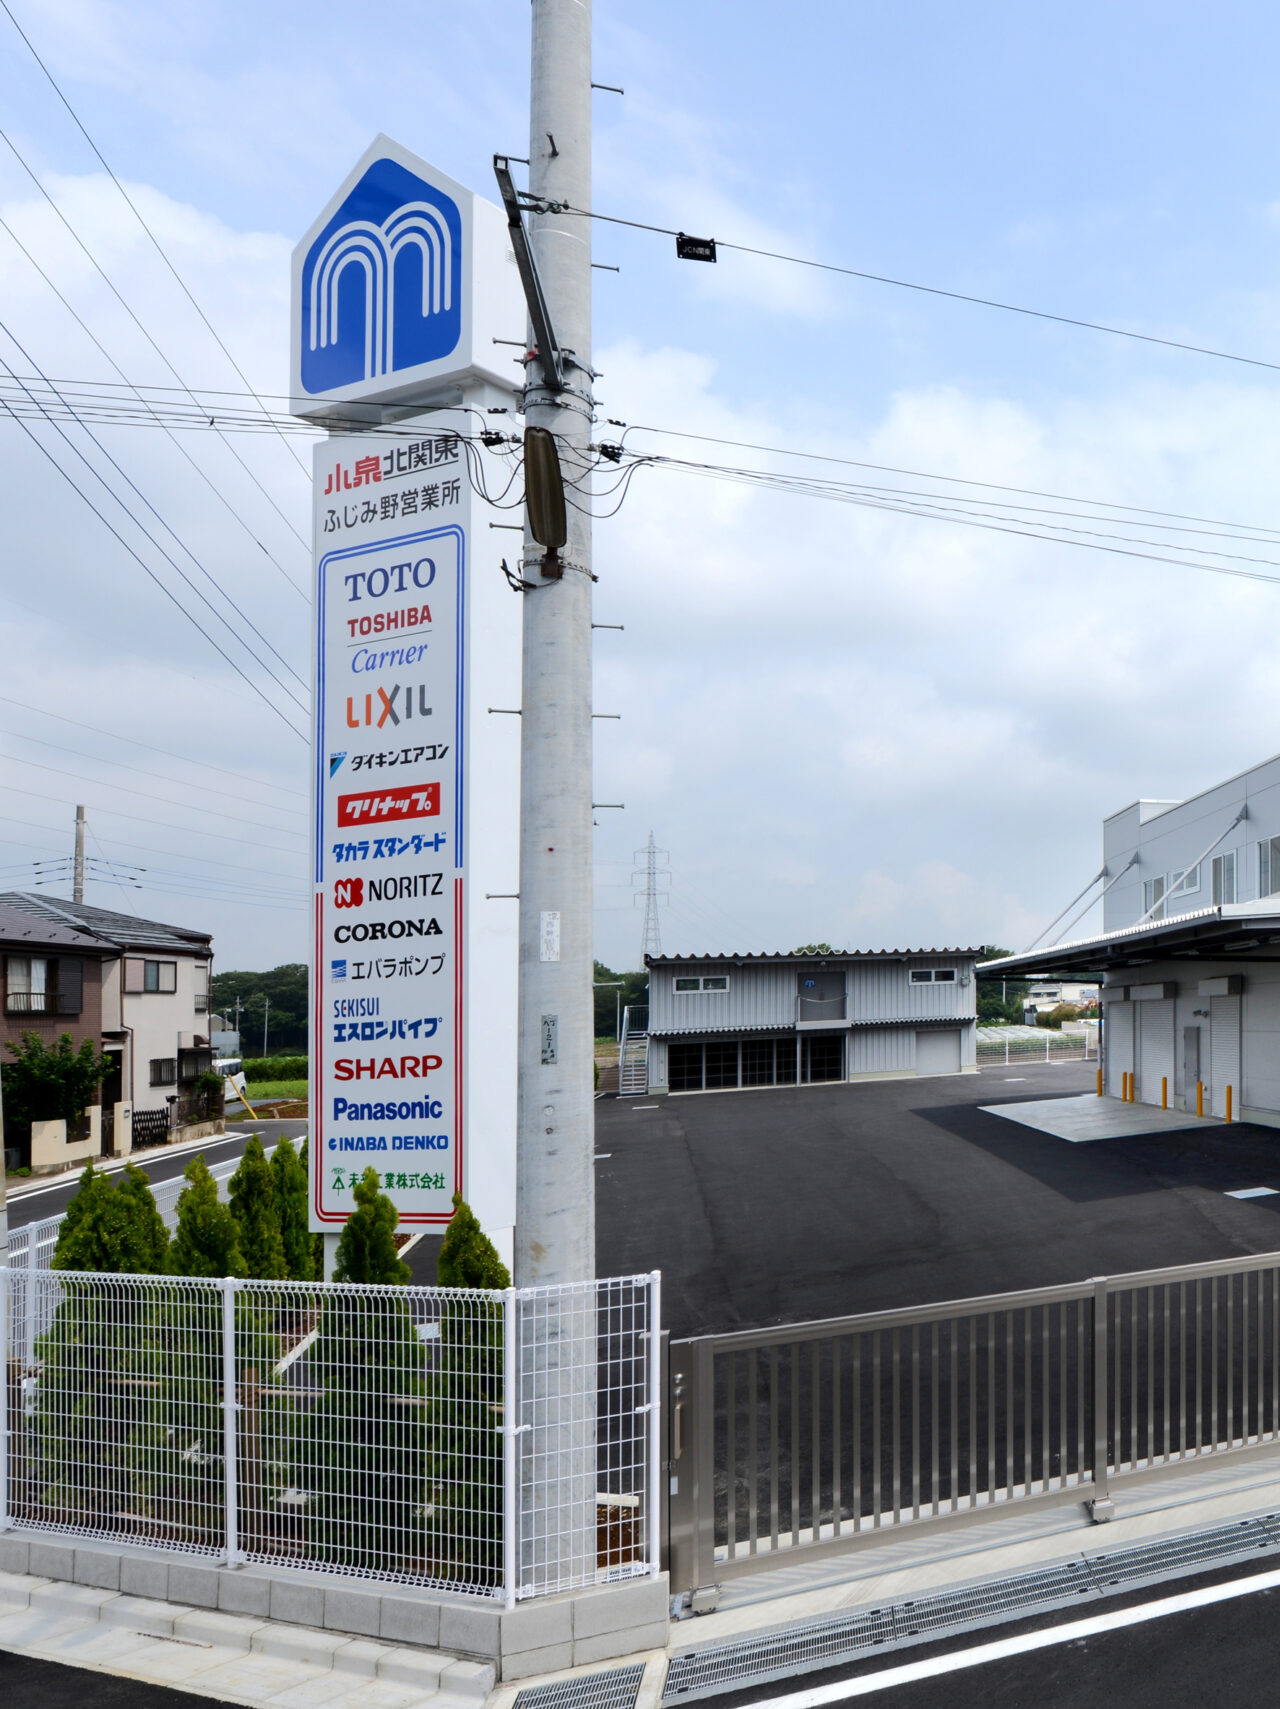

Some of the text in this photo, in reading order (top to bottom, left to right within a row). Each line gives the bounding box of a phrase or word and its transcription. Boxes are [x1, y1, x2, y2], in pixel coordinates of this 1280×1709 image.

[324, 437, 459, 495] 小泉北関東
[323, 477, 461, 533] ふじみ野営業所
[344, 557, 436, 602] TOTO
[347, 604, 432, 638] TOSHIBA
[351, 643, 429, 674] Carrier
[346, 683, 433, 729] LIXIL
[351, 743, 449, 771] ダイキンエアコン
[345, 791, 432, 819] クリナップ
[332, 832, 447, 863] タカラスタンダード
[368, 872, 443, 902] NORITZ
[334, 917, 443, 944] CORONA
[351, 952, 446, 980] エバラポンプ
[334, 997, 380, 1018] SEKISUI
[333, 1016, 443, 1043] エスロンパイプ
[334, 1054, 443, 1081] SHARP
[333, 1094, 443, 1121] Panasonic
[339, 1135, 449, 1151] INABA DENKO
